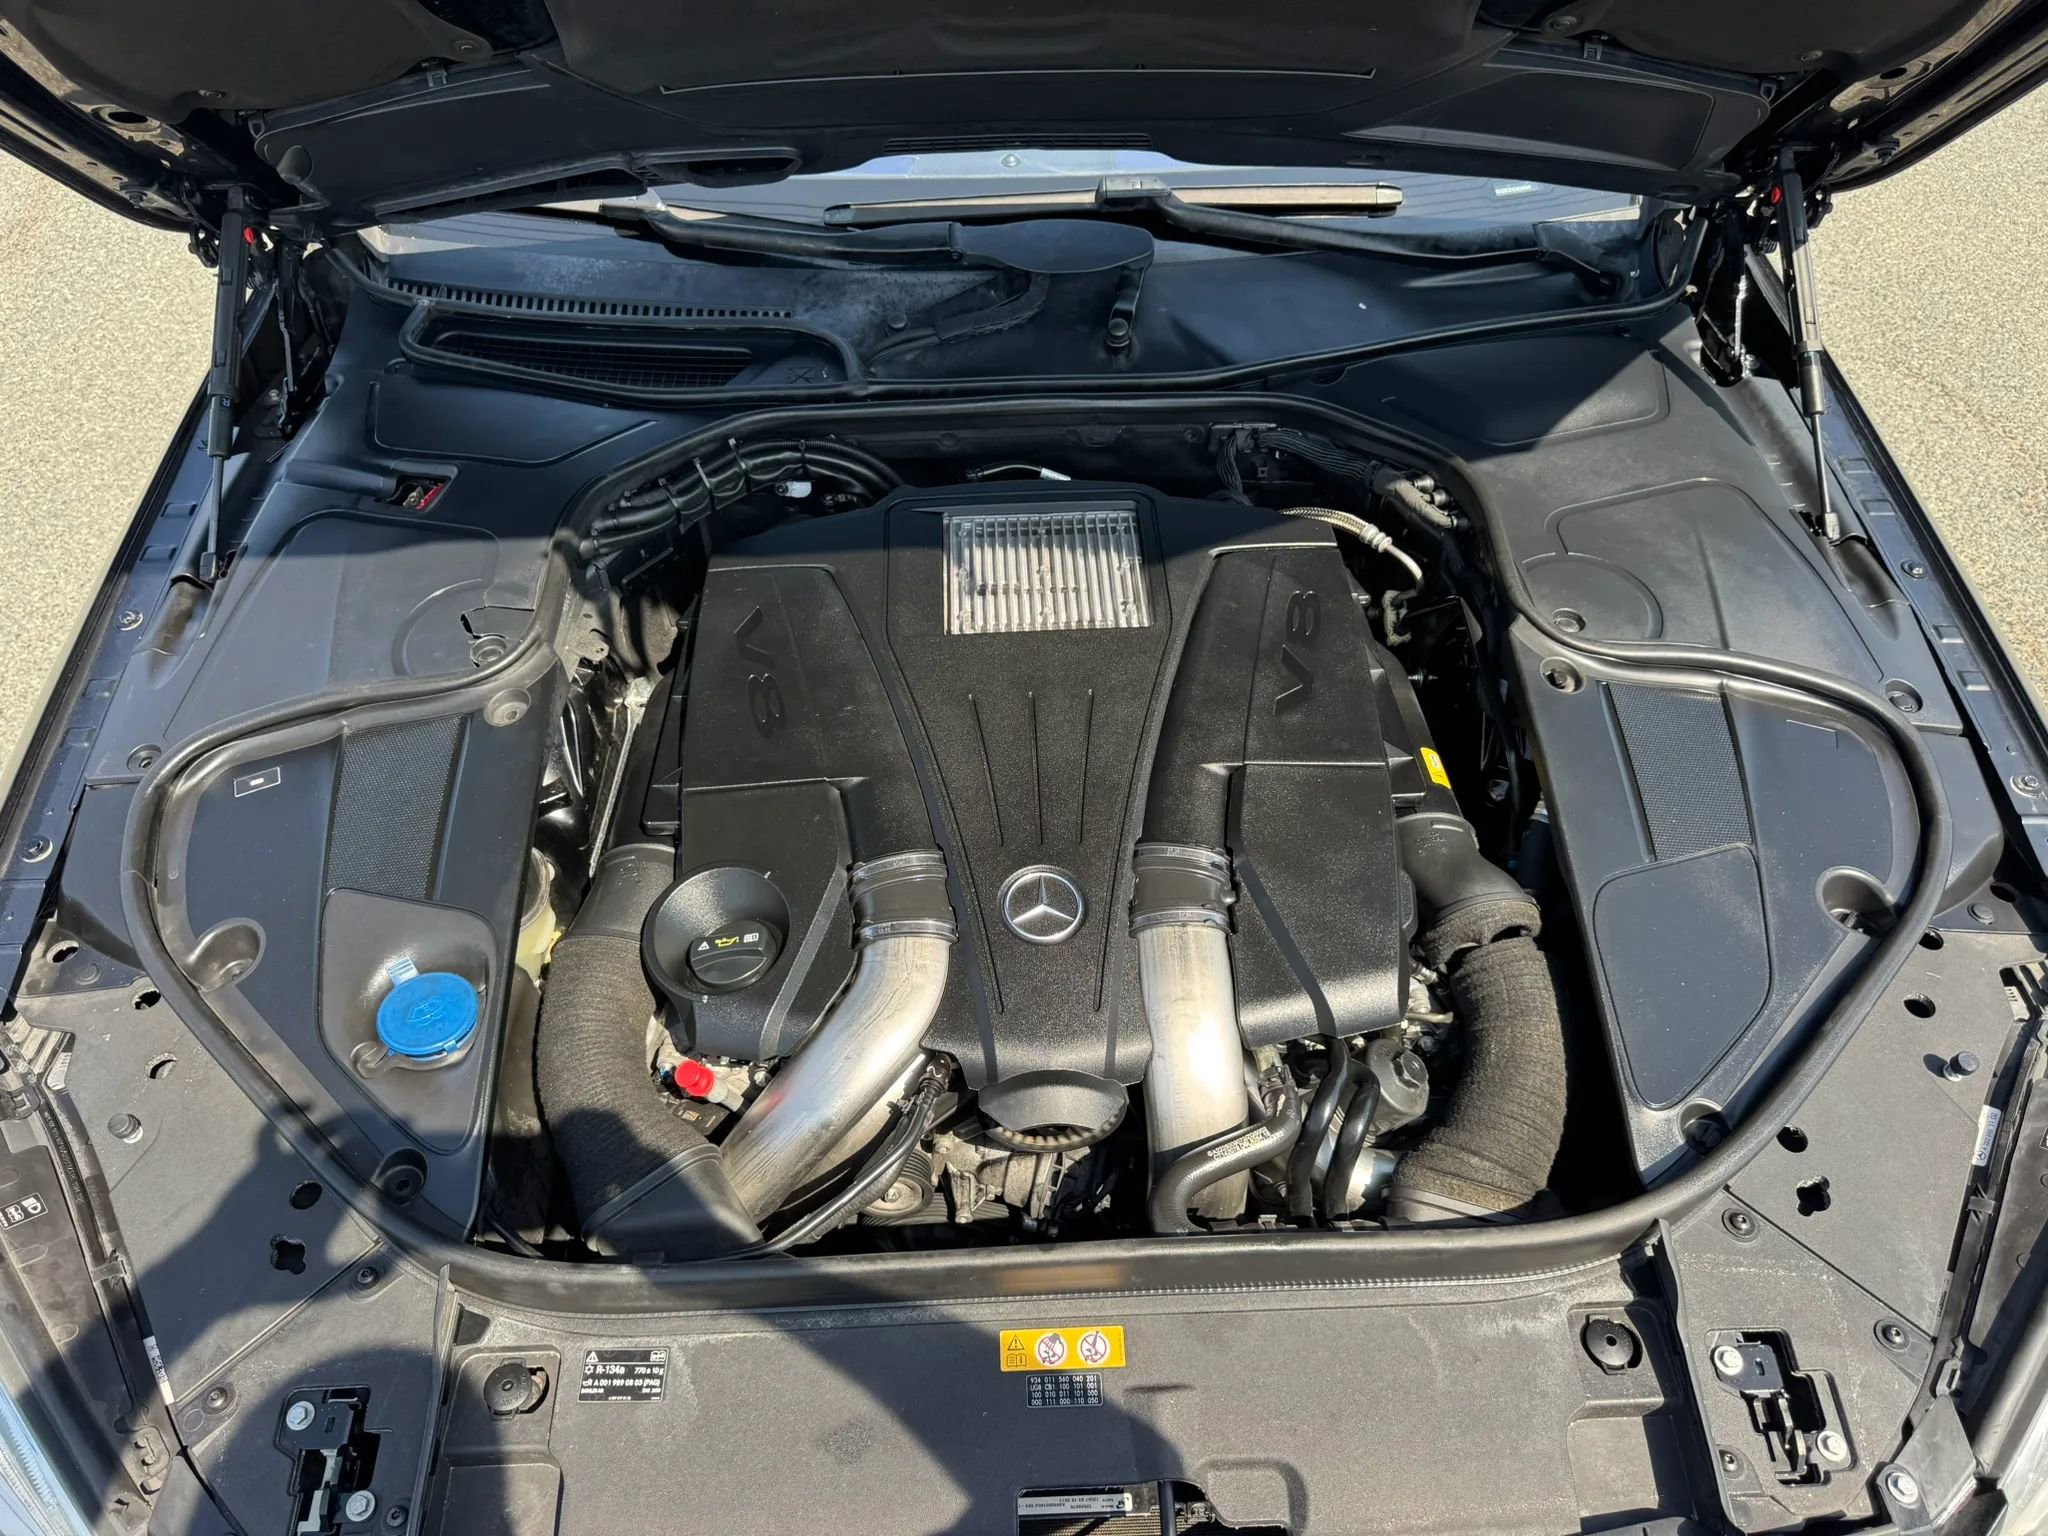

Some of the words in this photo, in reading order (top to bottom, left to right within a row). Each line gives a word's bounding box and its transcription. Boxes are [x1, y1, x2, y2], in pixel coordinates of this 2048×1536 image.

[734, 604, 787, 738] V8
[1272, 590, 1321, 716] V8
[596, 1365, 625, 1374] R-134a
[643, 1379, 660, 1387] (PAG)
